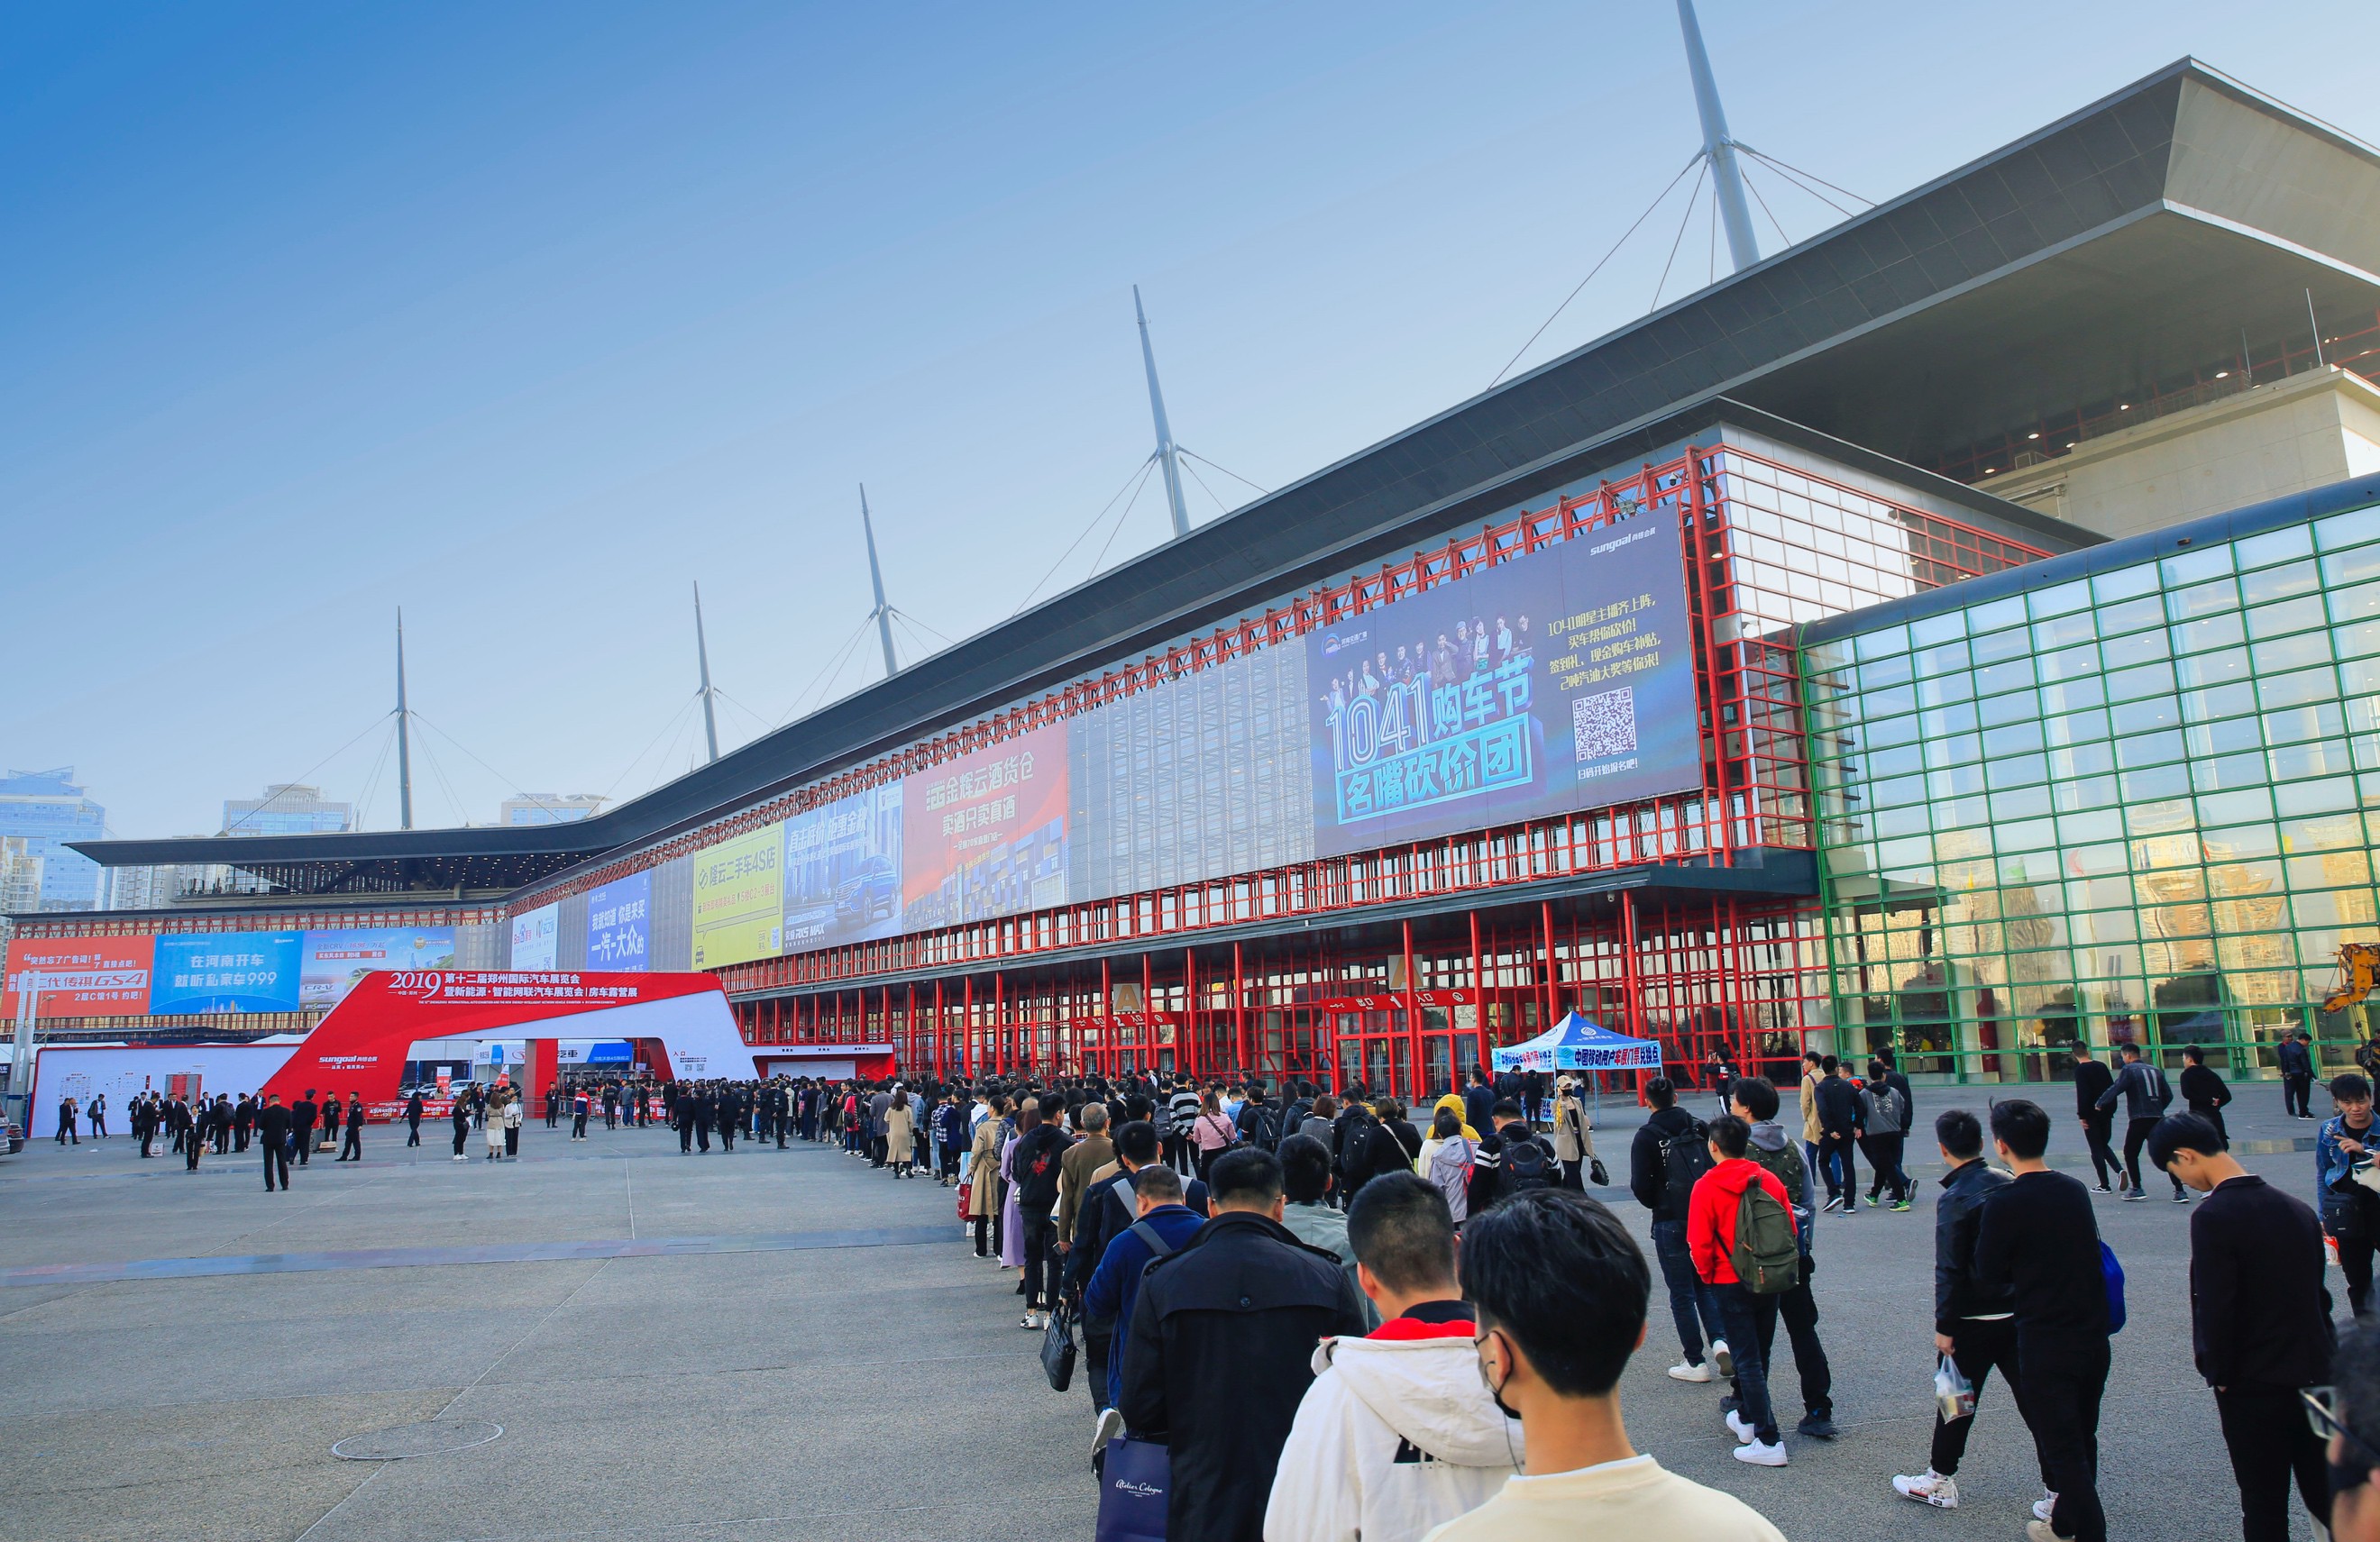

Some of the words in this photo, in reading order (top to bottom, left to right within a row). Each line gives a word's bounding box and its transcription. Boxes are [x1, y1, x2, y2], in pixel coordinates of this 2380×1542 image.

[1590, 534, 1631, 556] sungoal
[1569, 617, 1636, 650] 买车帮你砍价！
[1325, 654, 1535, 773] 1041购车节
[947, 751, 1035, 804] 金辉云酒货仓
[1345, 721, 1524, 814] 名嘴砍价团
[943, 794, 1016, 837] 卖酒只卖真酒
[591, 908, 617, 932] 我就知道
[618, 899, 645, 926] 你是来买
[810, 923, 825, 936] MAX
[591, 924, 645, 963] 一汽-大众的
[190, 953, 265, 969] 在河南开车
[1391, 955, 1424, 989] A
[175, 971, 278, 988] 就听私家车999
[388, 972, 442, 999] 2019
[444, 972, 581, 984] 第十二届郑州国际汽车展览会
[1115, 984, 1140, 1010] A
[1389, 995, 1403, 1008] 1
[1415, 992, 1434, 1003] 入口
[1112, 1016, 1126, 1027] 2
[318, 1054, 358, 1065] sungoal
[1574, 1045, 1660, 1067] 中国移动用户车展门票兑换点
[1115, 1479, 1138, 1490] Atelier
[1139, 1482, 1164, 1495] Cologne
